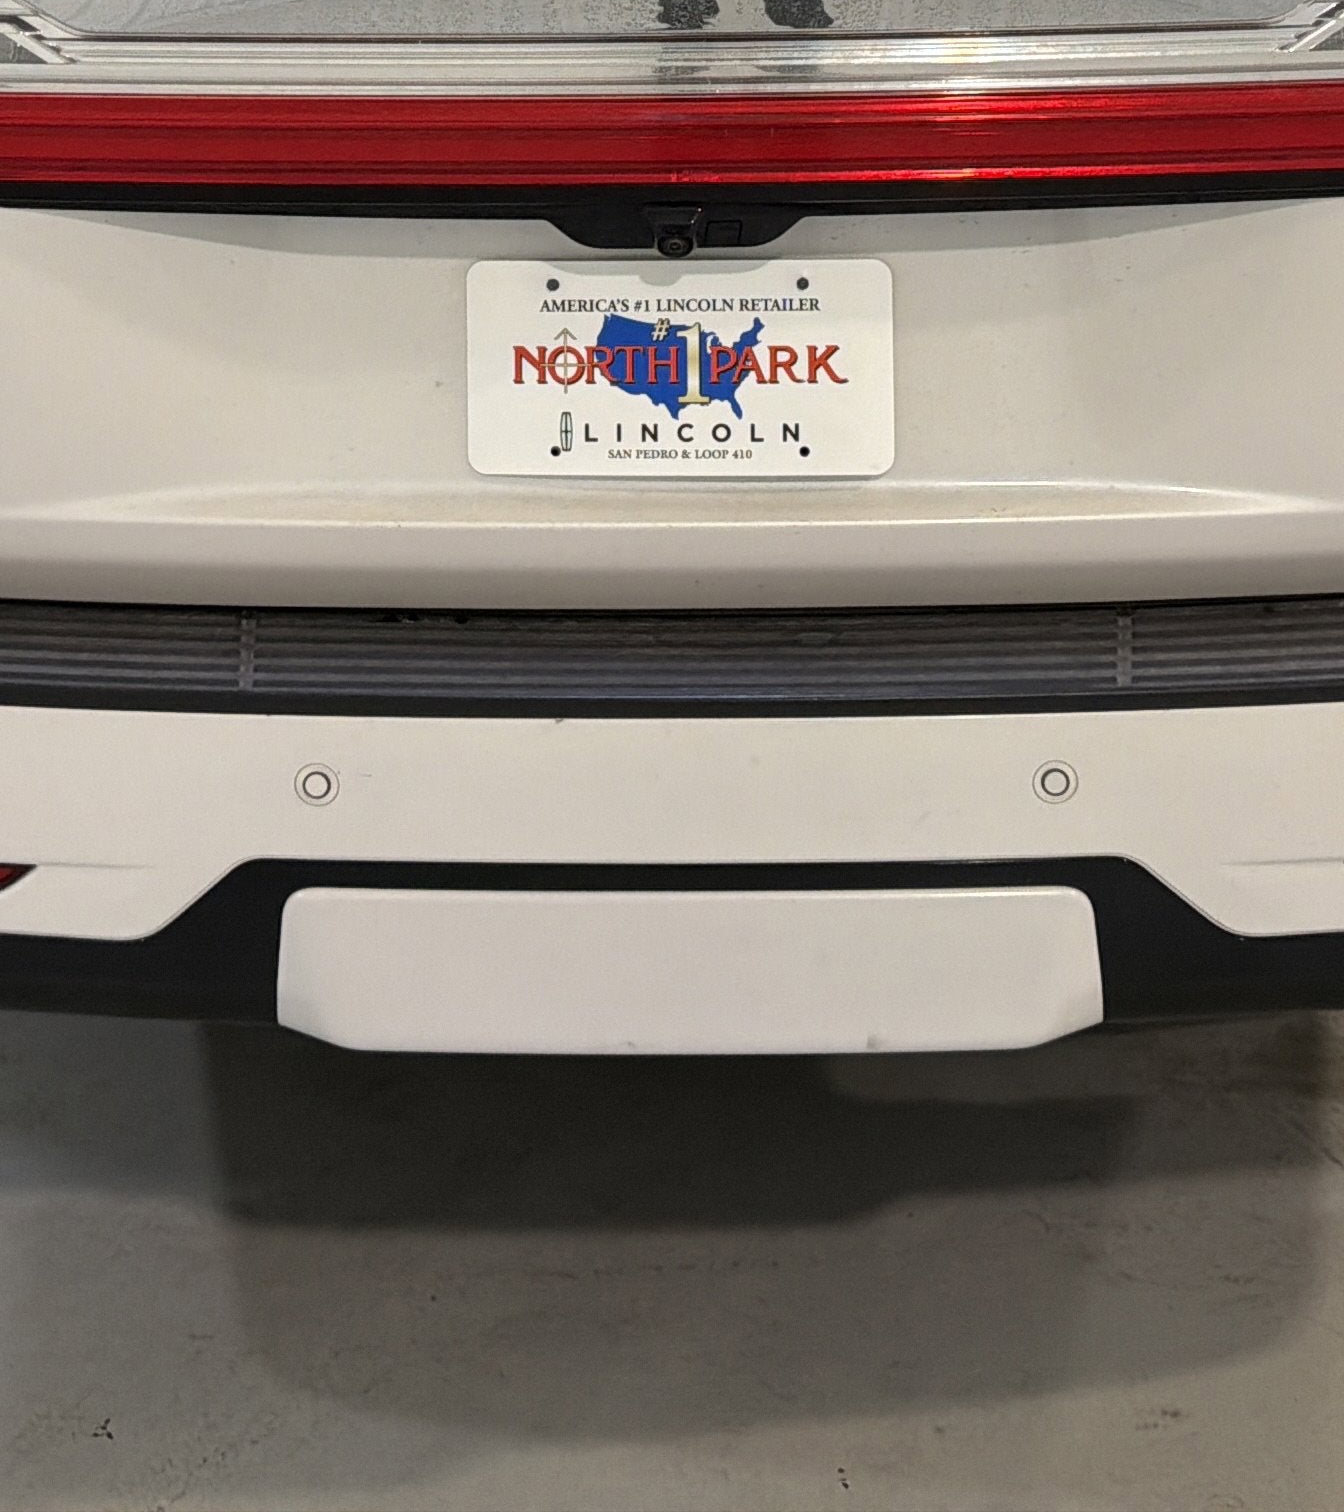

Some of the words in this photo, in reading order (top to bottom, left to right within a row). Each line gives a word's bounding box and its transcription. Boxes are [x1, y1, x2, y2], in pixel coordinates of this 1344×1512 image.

[540, 298, 629, 313] AMERICA'S
[634, 299, 650, 312] #1
[656, 298, 734, 312] LINCOLN
[739, 298, 820, 312] RETAILER
[512, 345, 679, 385] NORTH
[709, 344, 849, 385] PARK
[584, 423, 800, 443] LINCOLN
[607, 449, 632, 460] SAN
[636, 449, 678, 460] PEDRO
[681, 449, 691, 460] &
[695, 449, 729, 460] LOOP
[732, 449, 753, 460] 410
